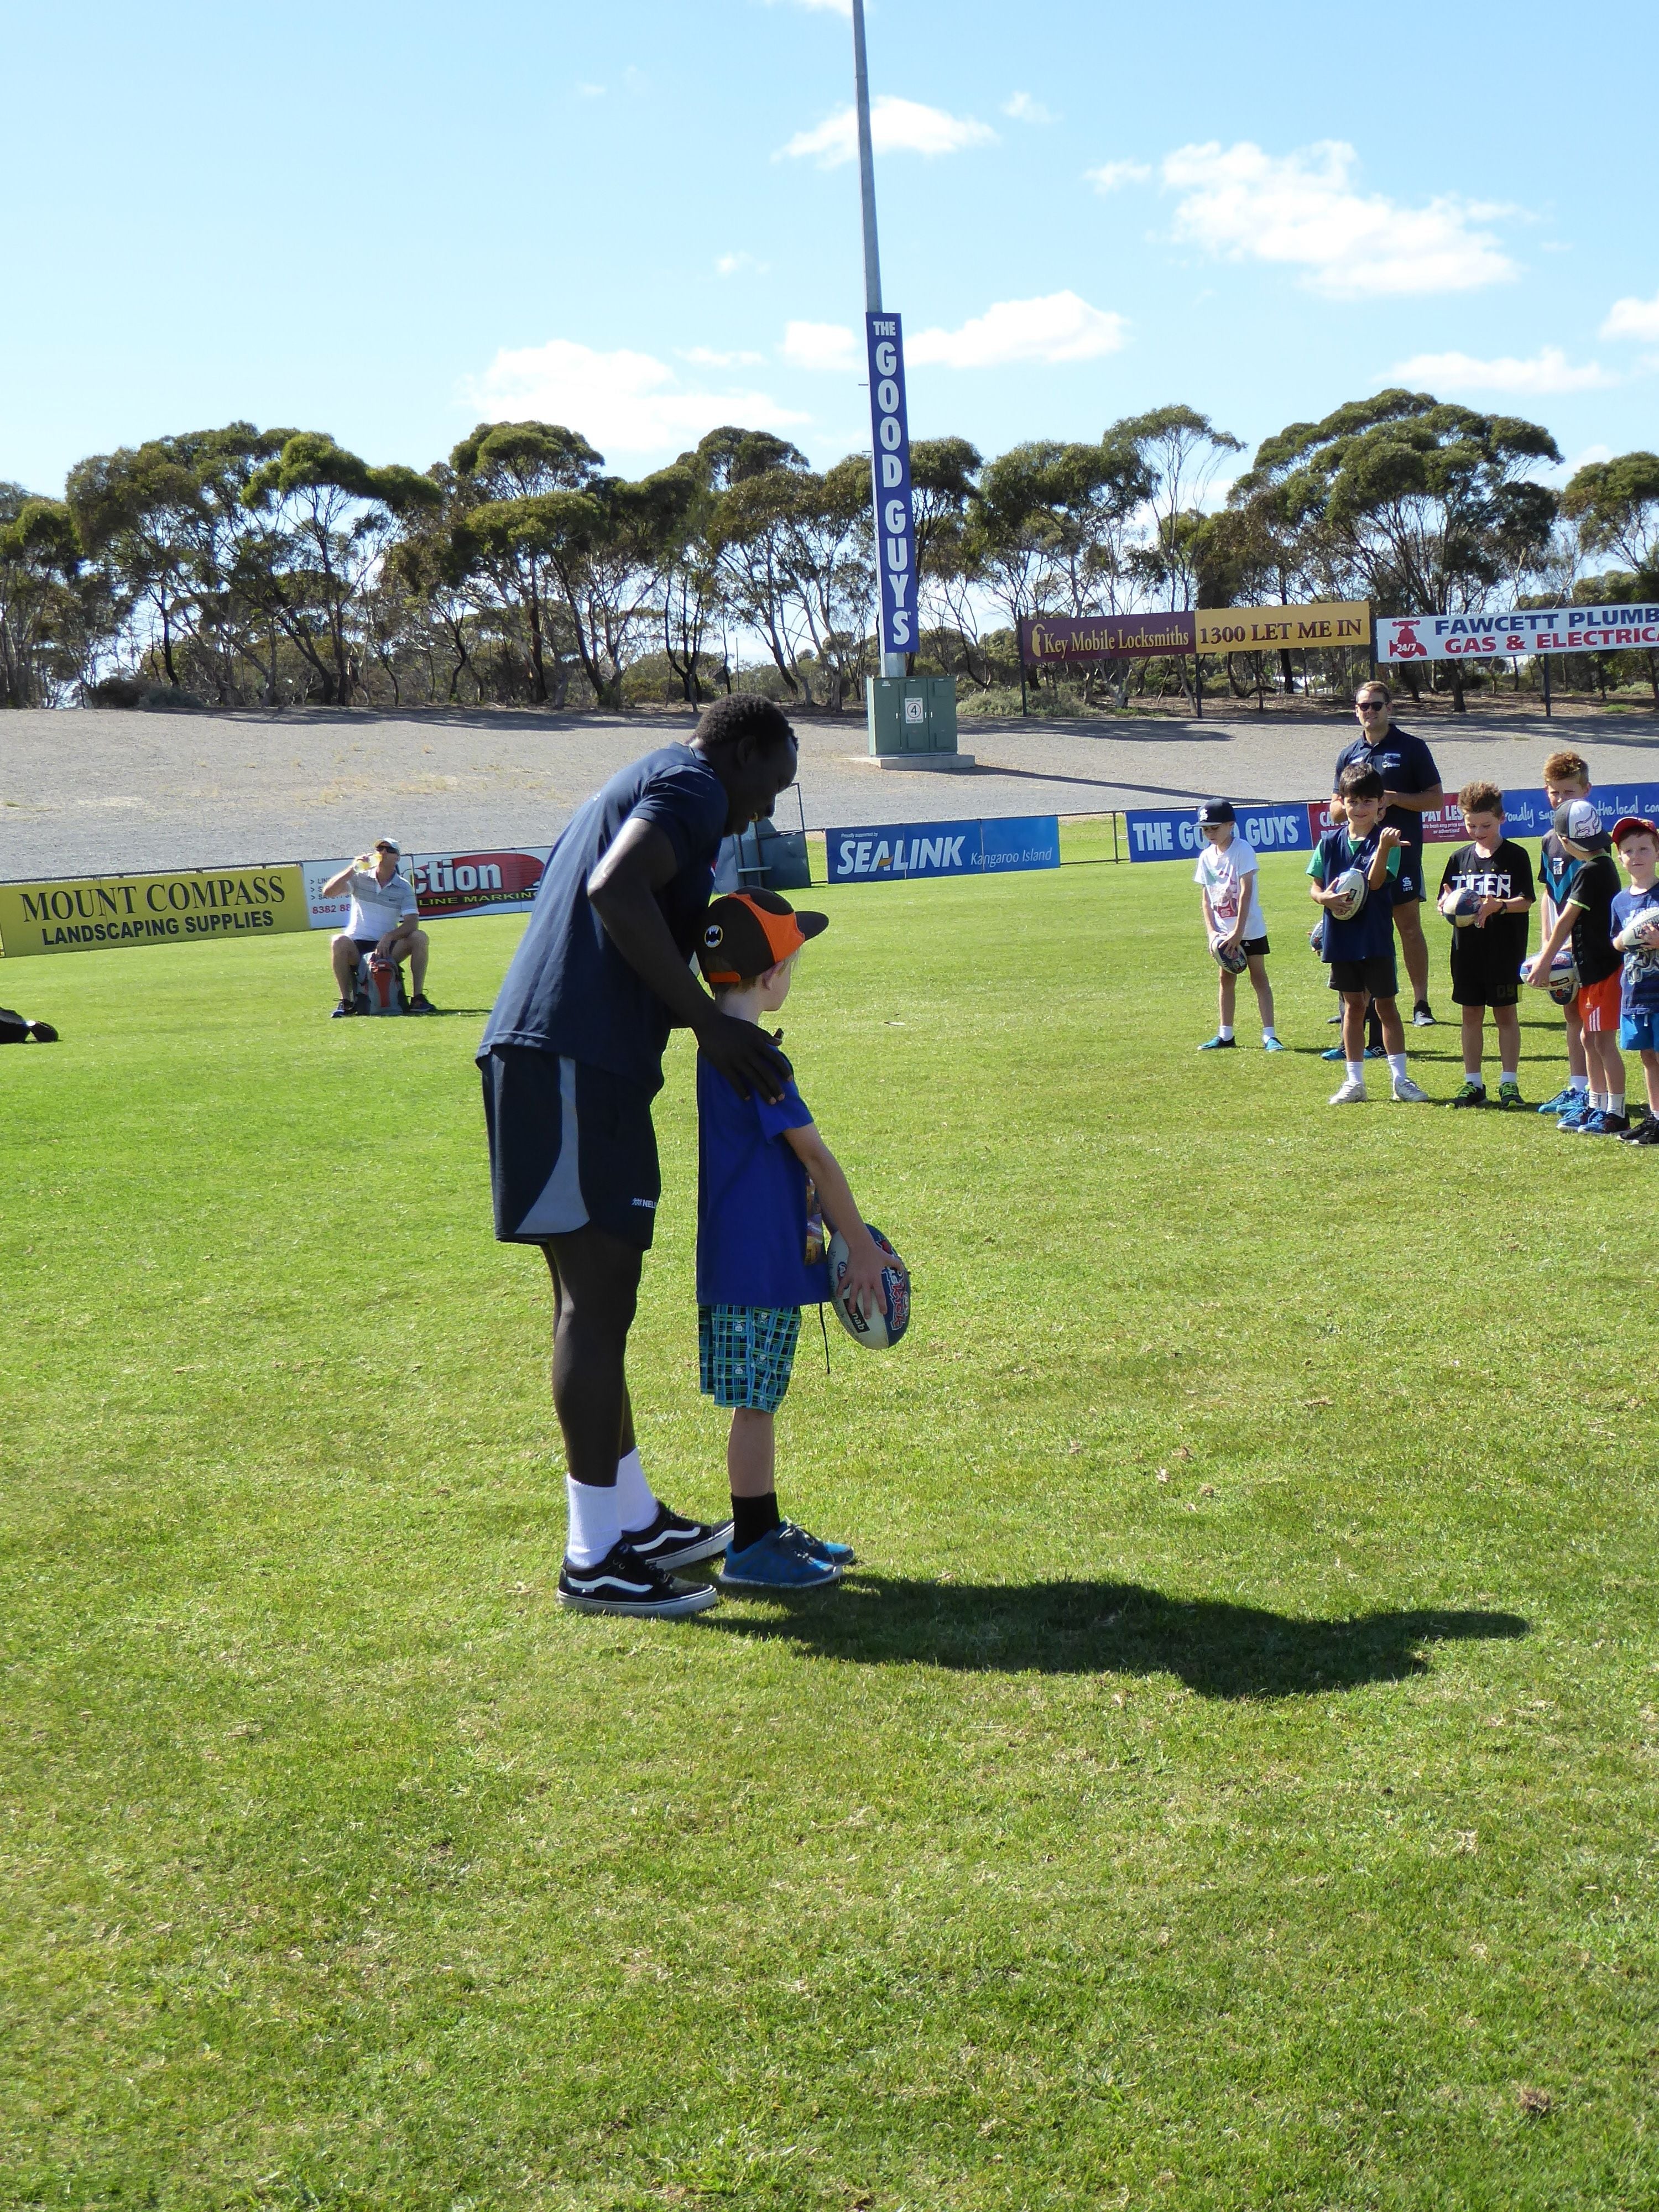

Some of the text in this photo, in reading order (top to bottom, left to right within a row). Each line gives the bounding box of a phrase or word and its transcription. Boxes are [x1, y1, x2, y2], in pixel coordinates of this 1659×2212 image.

[873, 321, 896, 336] THE
[876, 342, 903, 488] GOOD
[1200, 618, 1362, 645] 1300 LET ME IN
[1434, 608, 1659, 635] FAWCETT PLUMB
[1044, 624, 1189, 659] Key Mobile Locksmiths
[1396, 642, 1417, 653] 24/7
[1444, 627, 1659, 654] GAS & ELECTRIC
[910, 705, 917, 715] 4
[1422, 811, 1441, 822] PAY
[1505, 802, 1533, 828] roudly
[1616, 795, 1639, 815] local
[1133, 822, 1173, 852] THE
[1245, 815, 1299, 847] GUYS
[837, 836, 966, 875] SEALINK
[971, 847, 1052, 868] Kangaroo Island
[403, 859, 502, 895] ction
[1452, 874, 1511, 899] TIGER
[19, 875, 286, 922] MOUNT COMPASS
[312, 905, 336, 914] 8382
[419, 896, 458, 907] LINE
[41, 910, 274, 946] LANDSCAPING SUPPLIES
[852, 1313, 865, 1329] nab
